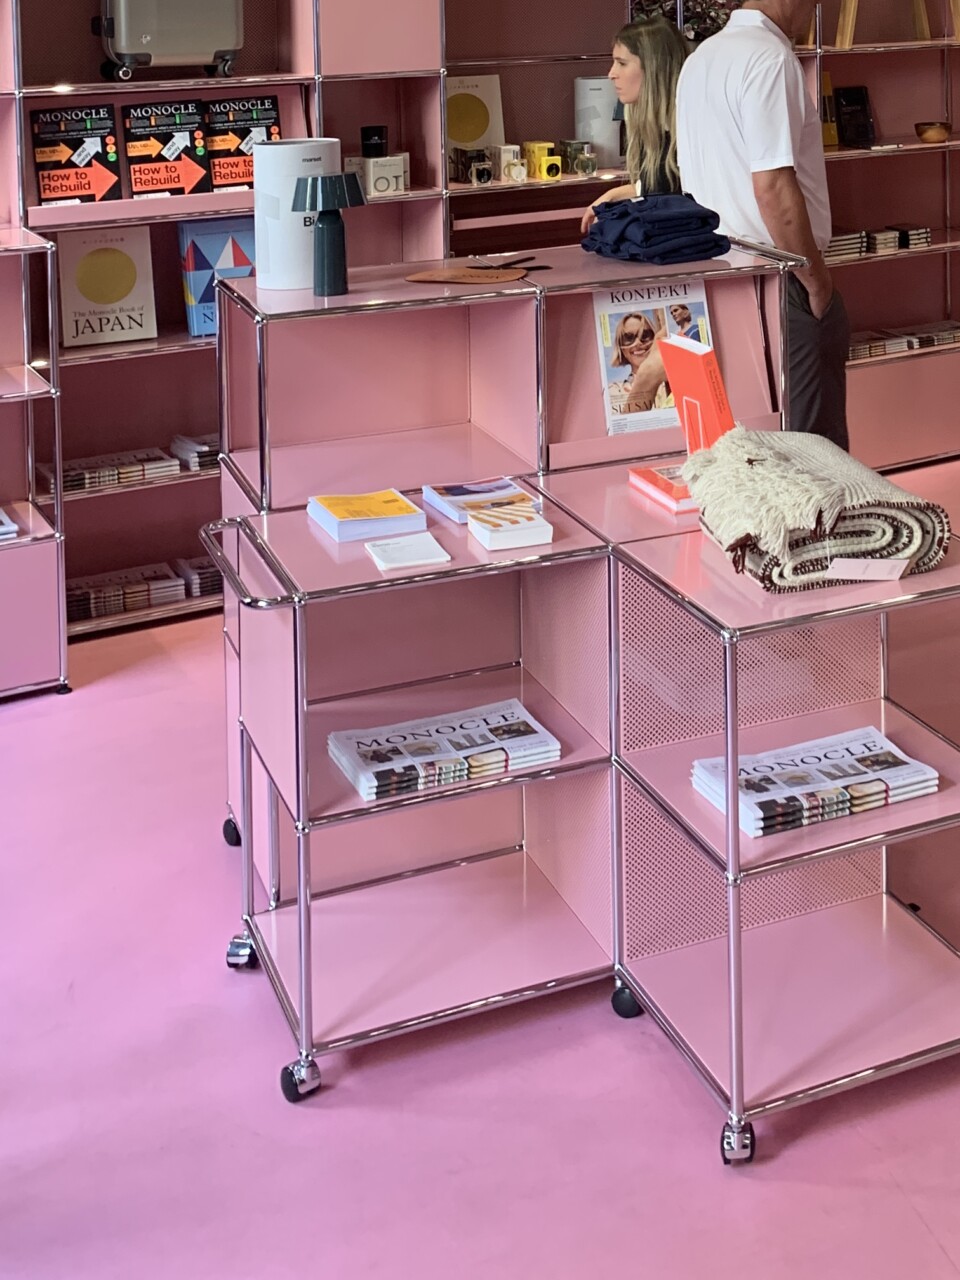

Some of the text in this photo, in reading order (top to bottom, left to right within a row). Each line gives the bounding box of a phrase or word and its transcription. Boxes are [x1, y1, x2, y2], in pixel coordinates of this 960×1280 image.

[130, 103, 196, 118] MONOCLE
[209, 100, 272, 113] MONOCLE
[40, 108, 108, 122] MONOCLE
[132, 164, 177, 176] How to
[212, 158, 253, 170] How to
[41, 170, 87, 183] How to
[134, 174, 180, 187] Rebuild
[42, 181, 91, 194] Rebuild
[304, 216, 315, 227] Bi
[610, 284, 691, 304] KONFEKT
[88, 308, 118, 317] Monocle
[72, 314, 144, 339] JAPAN
[355, 711, 522, 750] MONOCLE
